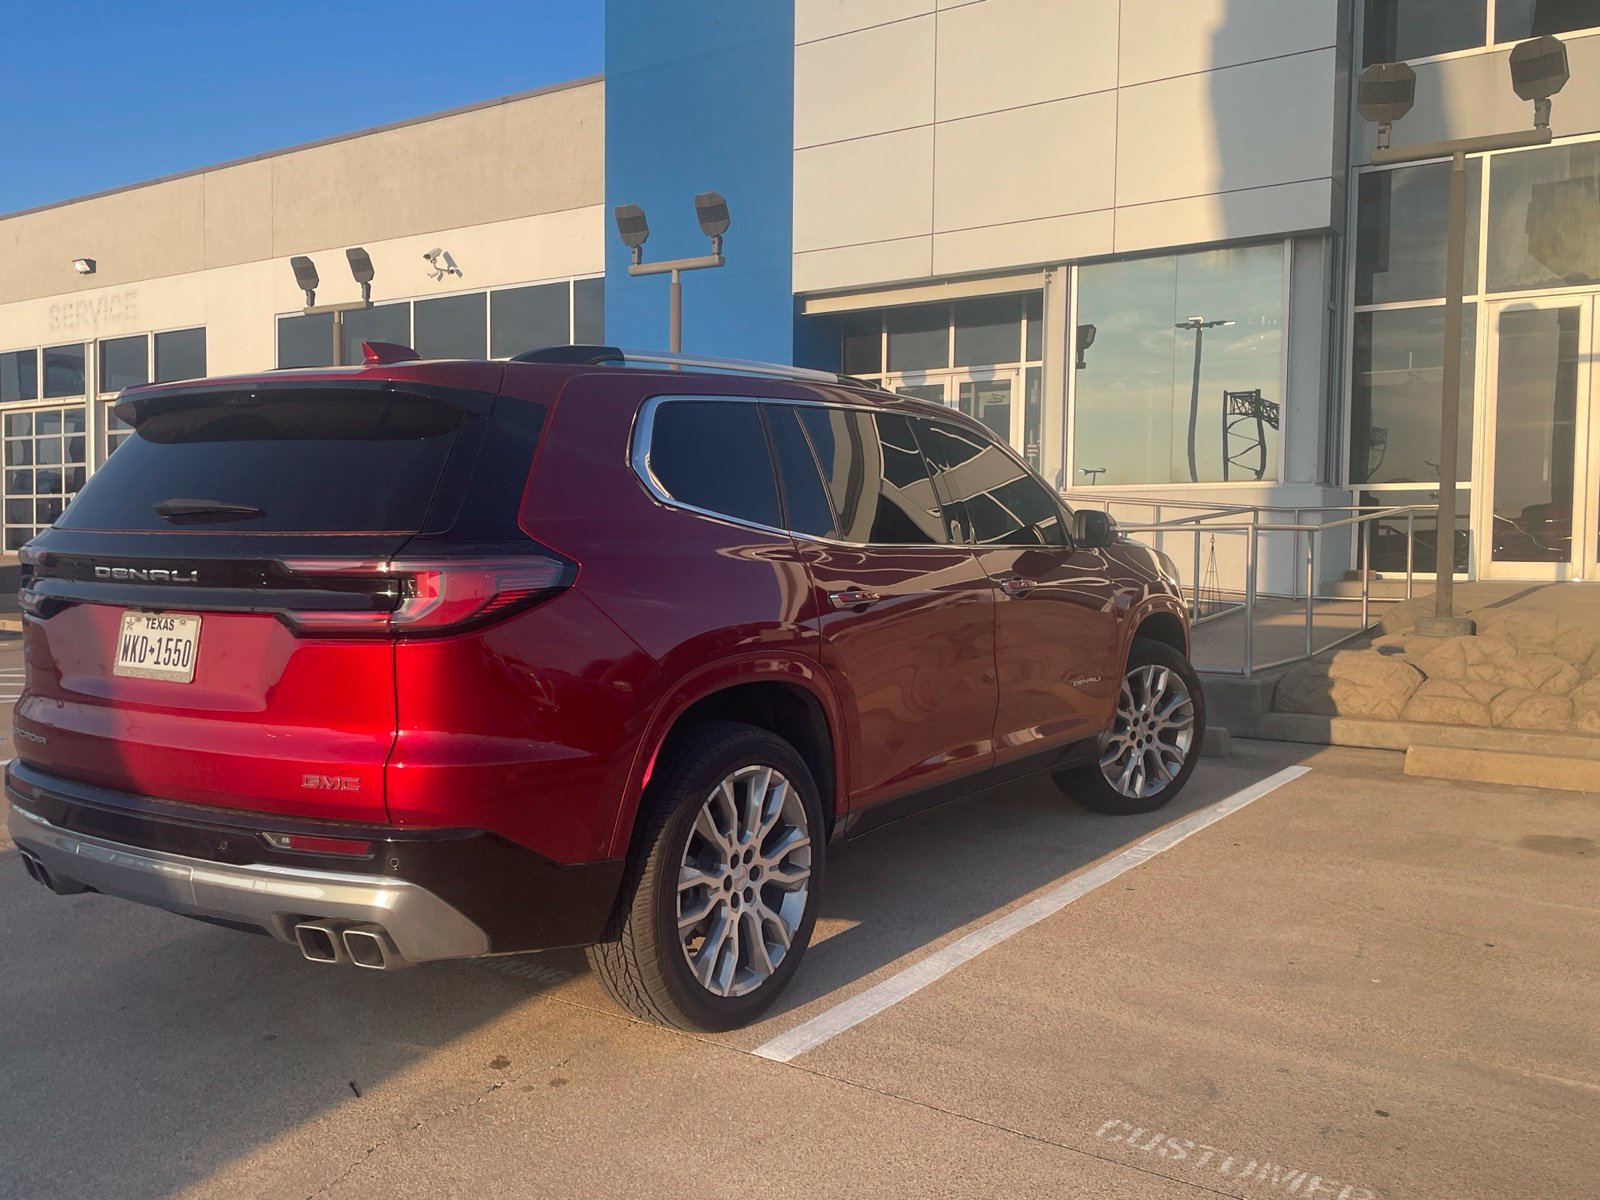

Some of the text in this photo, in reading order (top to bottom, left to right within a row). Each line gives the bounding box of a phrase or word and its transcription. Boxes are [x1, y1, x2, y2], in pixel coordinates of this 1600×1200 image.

[50, 291, 138, 330] SERVICE
[94, 566, 198, 582] DENALI
[146, 617, 175, 631] TEXAS
[302, 774, 360, 791] GMC
